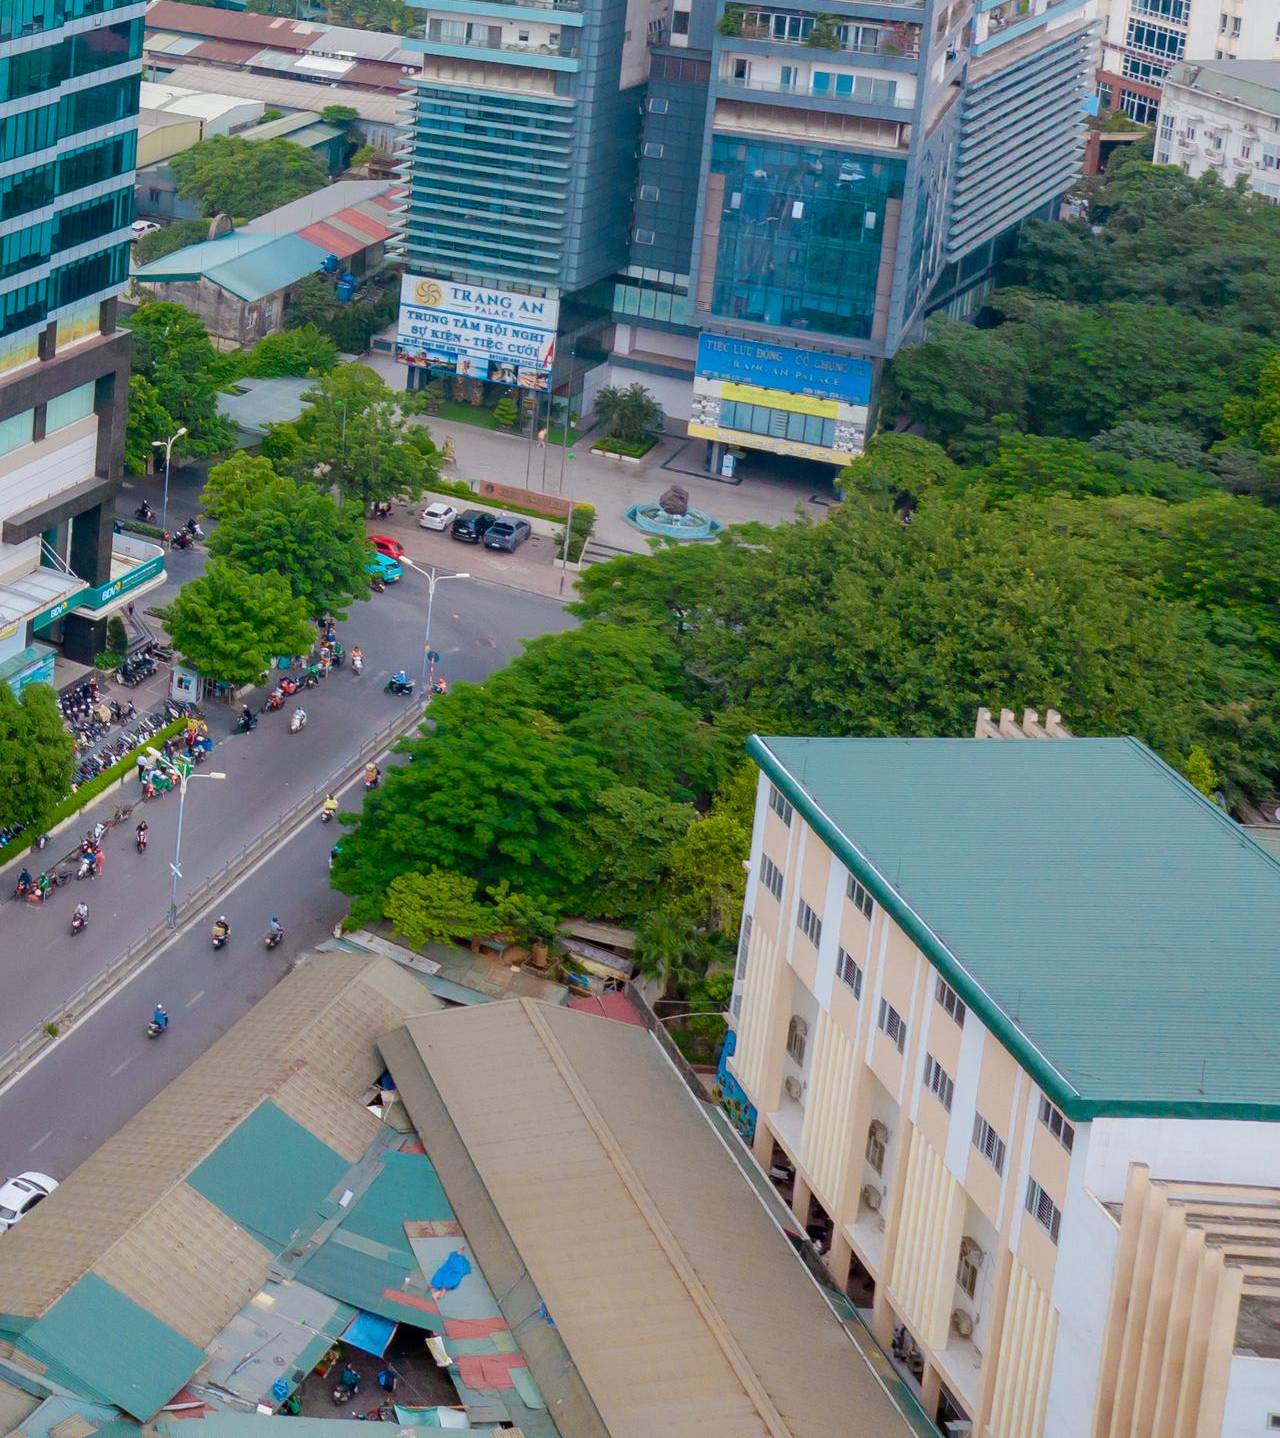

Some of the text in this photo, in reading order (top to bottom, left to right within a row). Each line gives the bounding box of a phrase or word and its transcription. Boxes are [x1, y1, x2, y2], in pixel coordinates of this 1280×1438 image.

[451, 287, 545, 314] TRANG AN
[475, 305, 514, 319] PALACE
[407, 310, 448, 325] TRUNG
[452, 317, 480, 330] TÂM
[485, 324, 507, 337] HỘI
